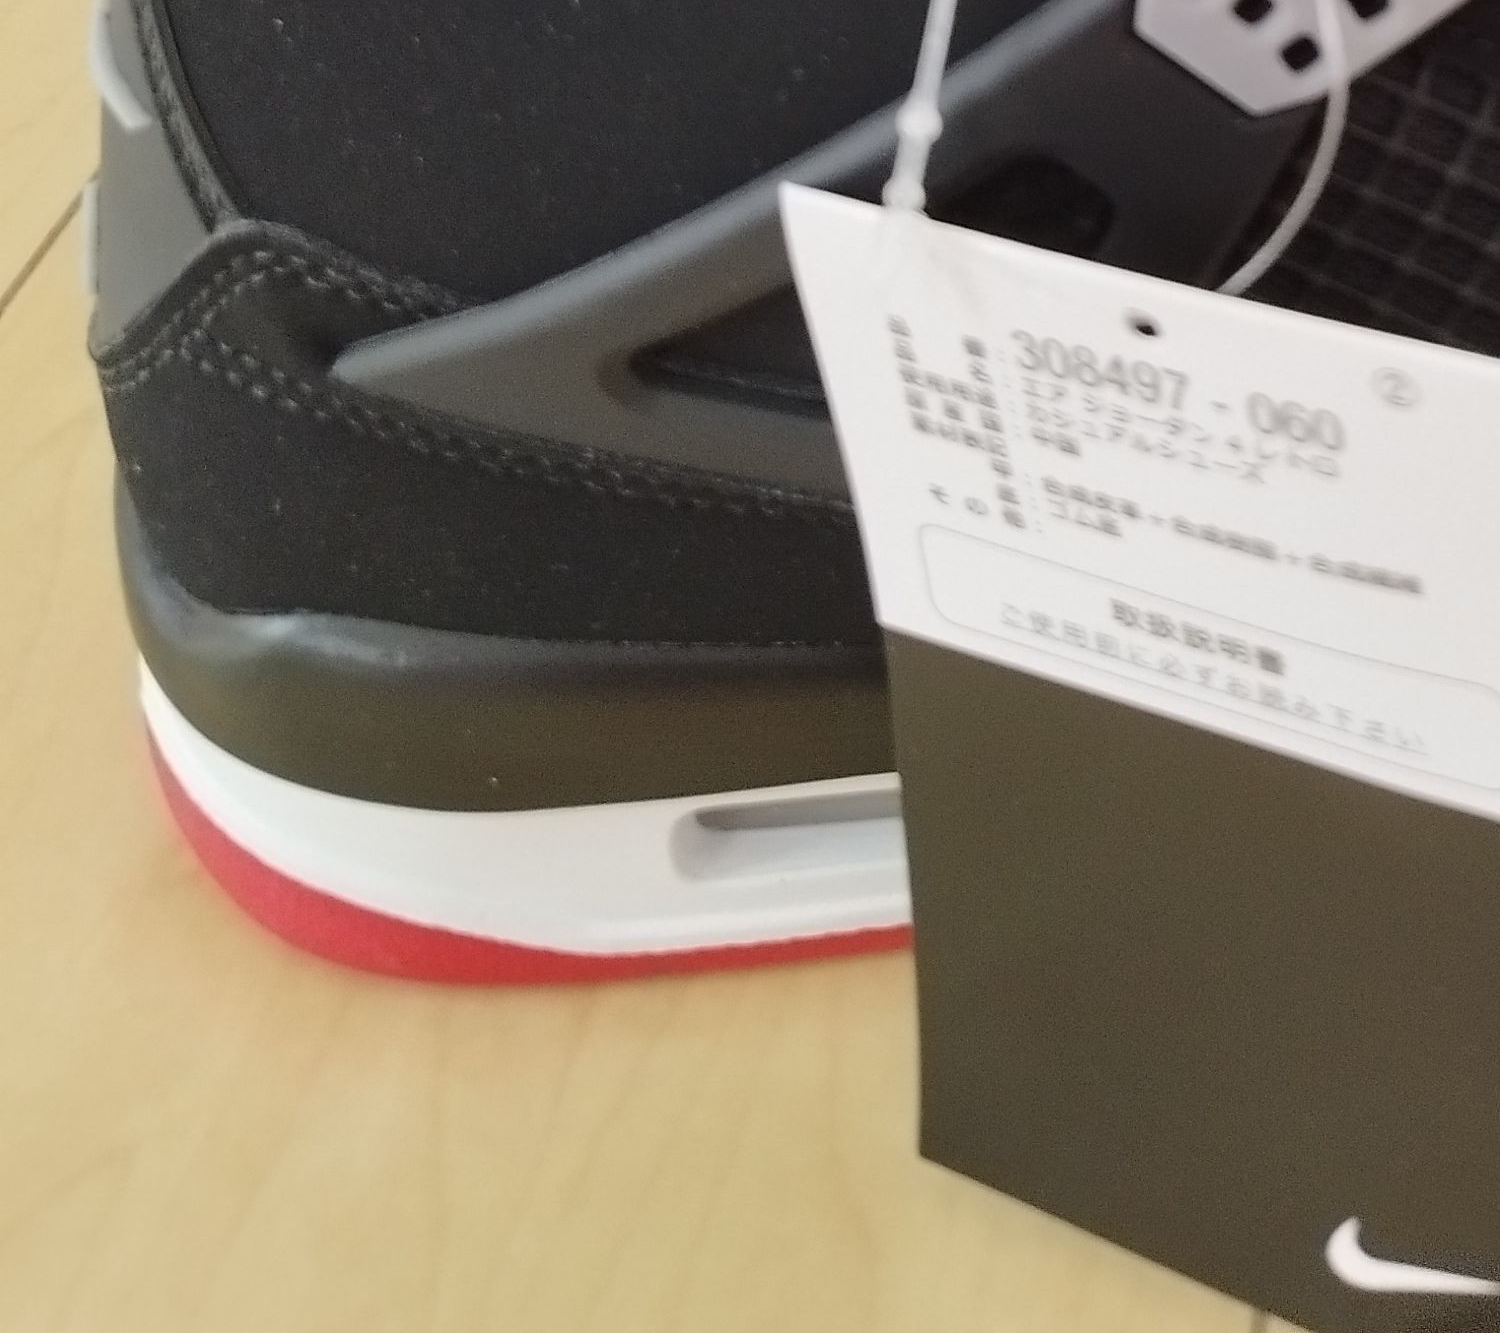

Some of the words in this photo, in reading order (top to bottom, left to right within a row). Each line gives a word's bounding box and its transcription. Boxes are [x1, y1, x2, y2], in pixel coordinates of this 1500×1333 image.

[1109, 597, 1287, 677] 取扱説明書
